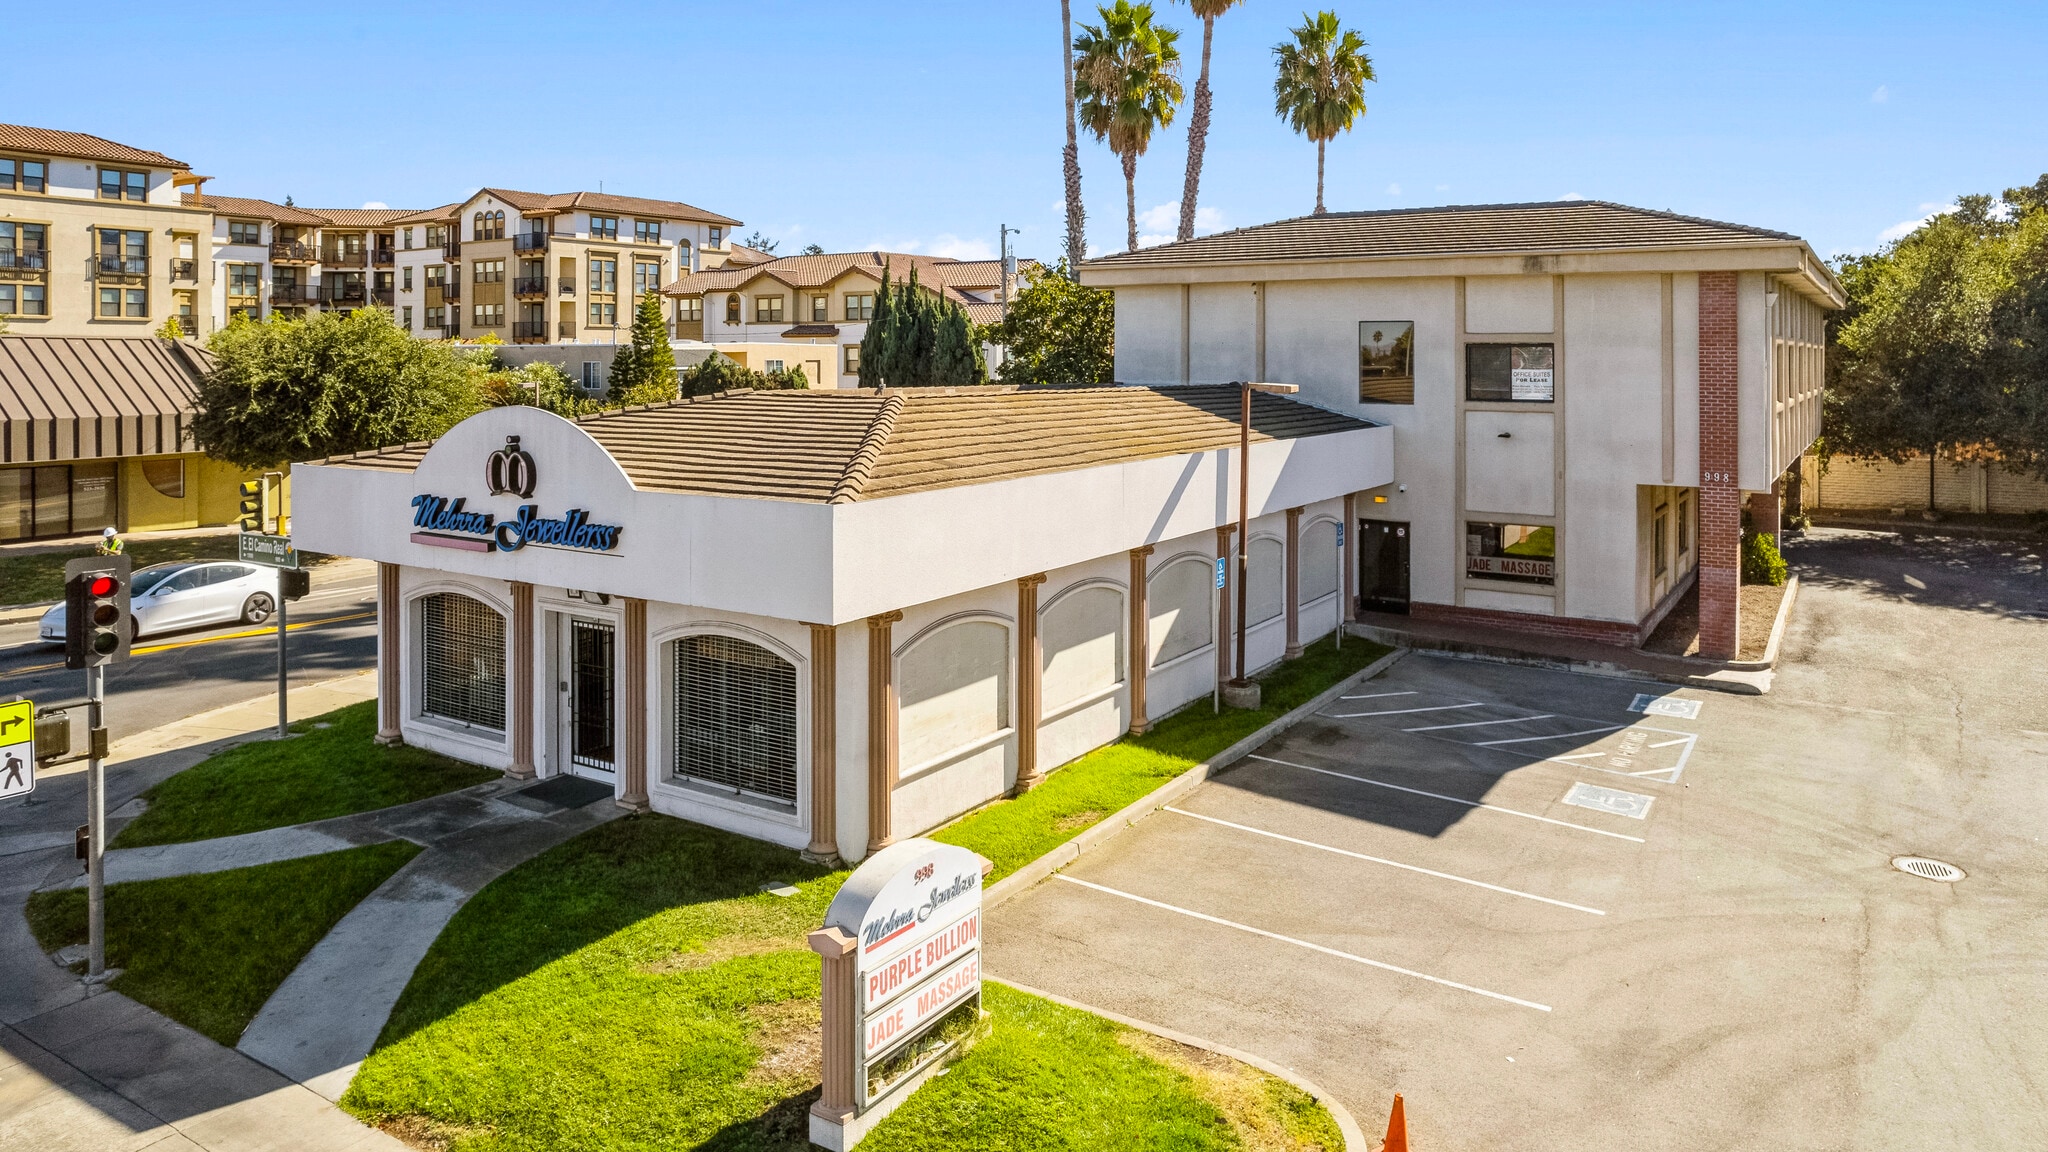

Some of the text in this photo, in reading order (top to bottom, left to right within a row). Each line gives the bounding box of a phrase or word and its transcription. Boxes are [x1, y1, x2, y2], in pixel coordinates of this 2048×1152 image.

[1704, 472, 1729, 483] 998
[254, 538, 273, 554] Camino
[273, 540, 284, 555] Real
[1467, 556, 1551, 576] JADE MASSAGE
[869, 915, 977, 1002] PURPLE BULLION
[867, 961, 977, 1050] JADE MASSAGE
